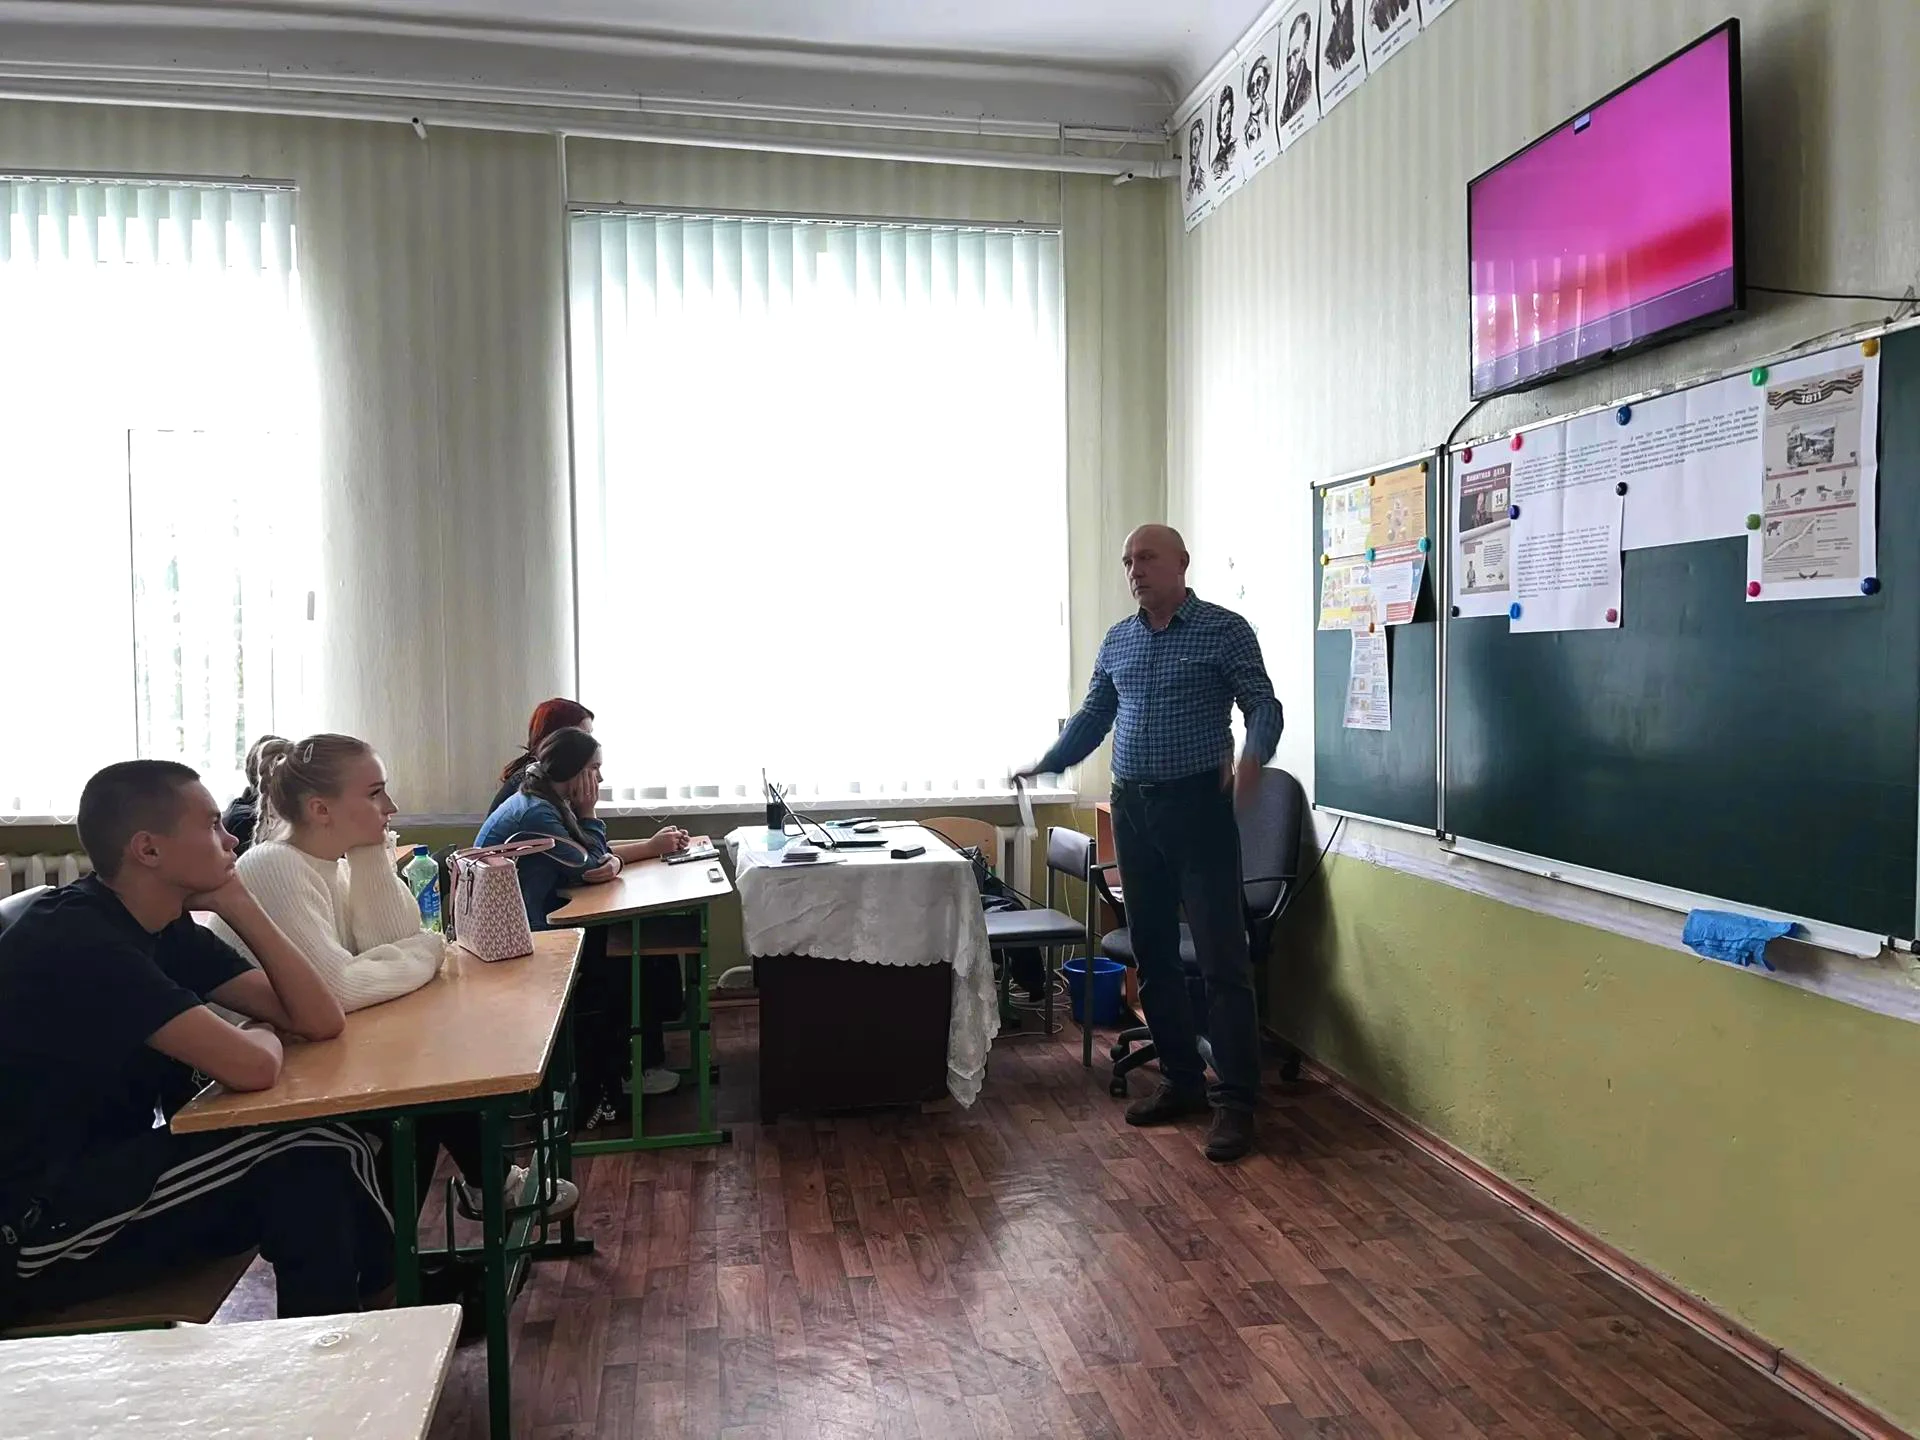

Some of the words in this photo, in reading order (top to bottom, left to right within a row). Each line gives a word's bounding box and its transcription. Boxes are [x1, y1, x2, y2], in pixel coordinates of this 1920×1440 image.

[1801, 391, 1822, 404] 1811
[1493, 467, 1505, 477] ДАТА
[1496, 493, 1503, 504] 14
